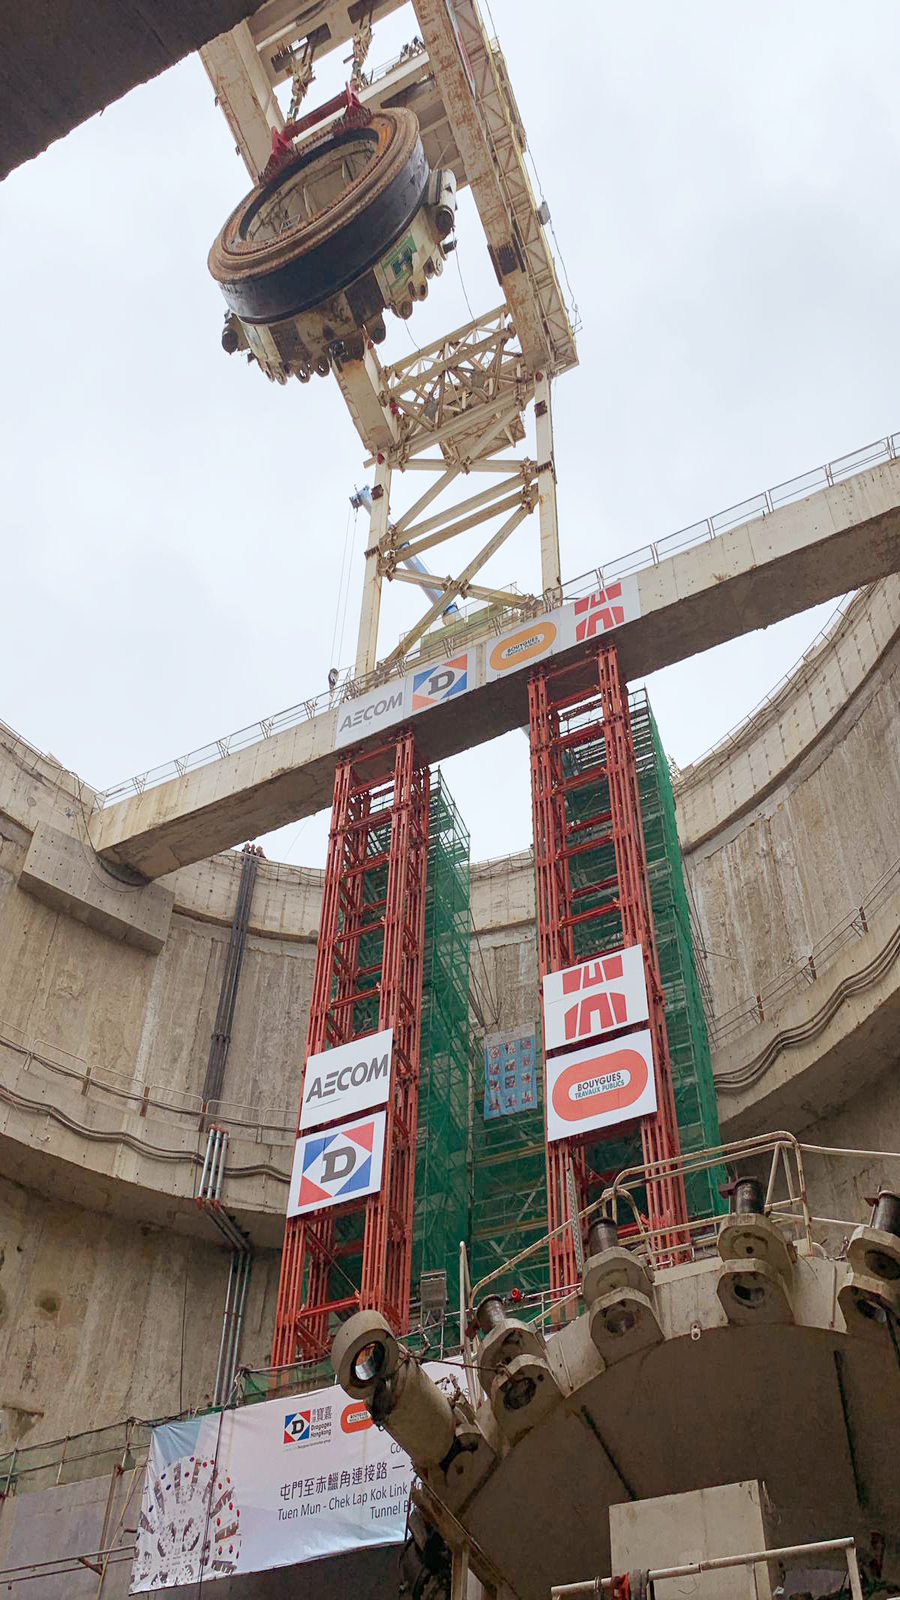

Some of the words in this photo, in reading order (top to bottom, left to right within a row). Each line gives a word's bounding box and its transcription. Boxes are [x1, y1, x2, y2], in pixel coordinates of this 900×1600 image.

[428, 670, 455, 696] D
[339, 691, 403, 733] AECOM
[305, 1053, 389, 1104] AECOM
[574, 1086, 601, 1100] TRAVAUX
[601, 1079, 625, 1092] PUBLICS
[577, 1071, 622, 1092] BOUYGUES
[320, 1145, 357, 1184] D
[277, 1507, 298, 1521] Tuen
[300, 1501, 321, 1517] Mun
[328, 1495, 351, 1511] Chek
[352, 1491, 368, 1506] Lap
[370, 1485, 389, 1502] Kok
[389, 1481, 408, 1498] Link
[369, 1502, 401, 1520] Tunnel
